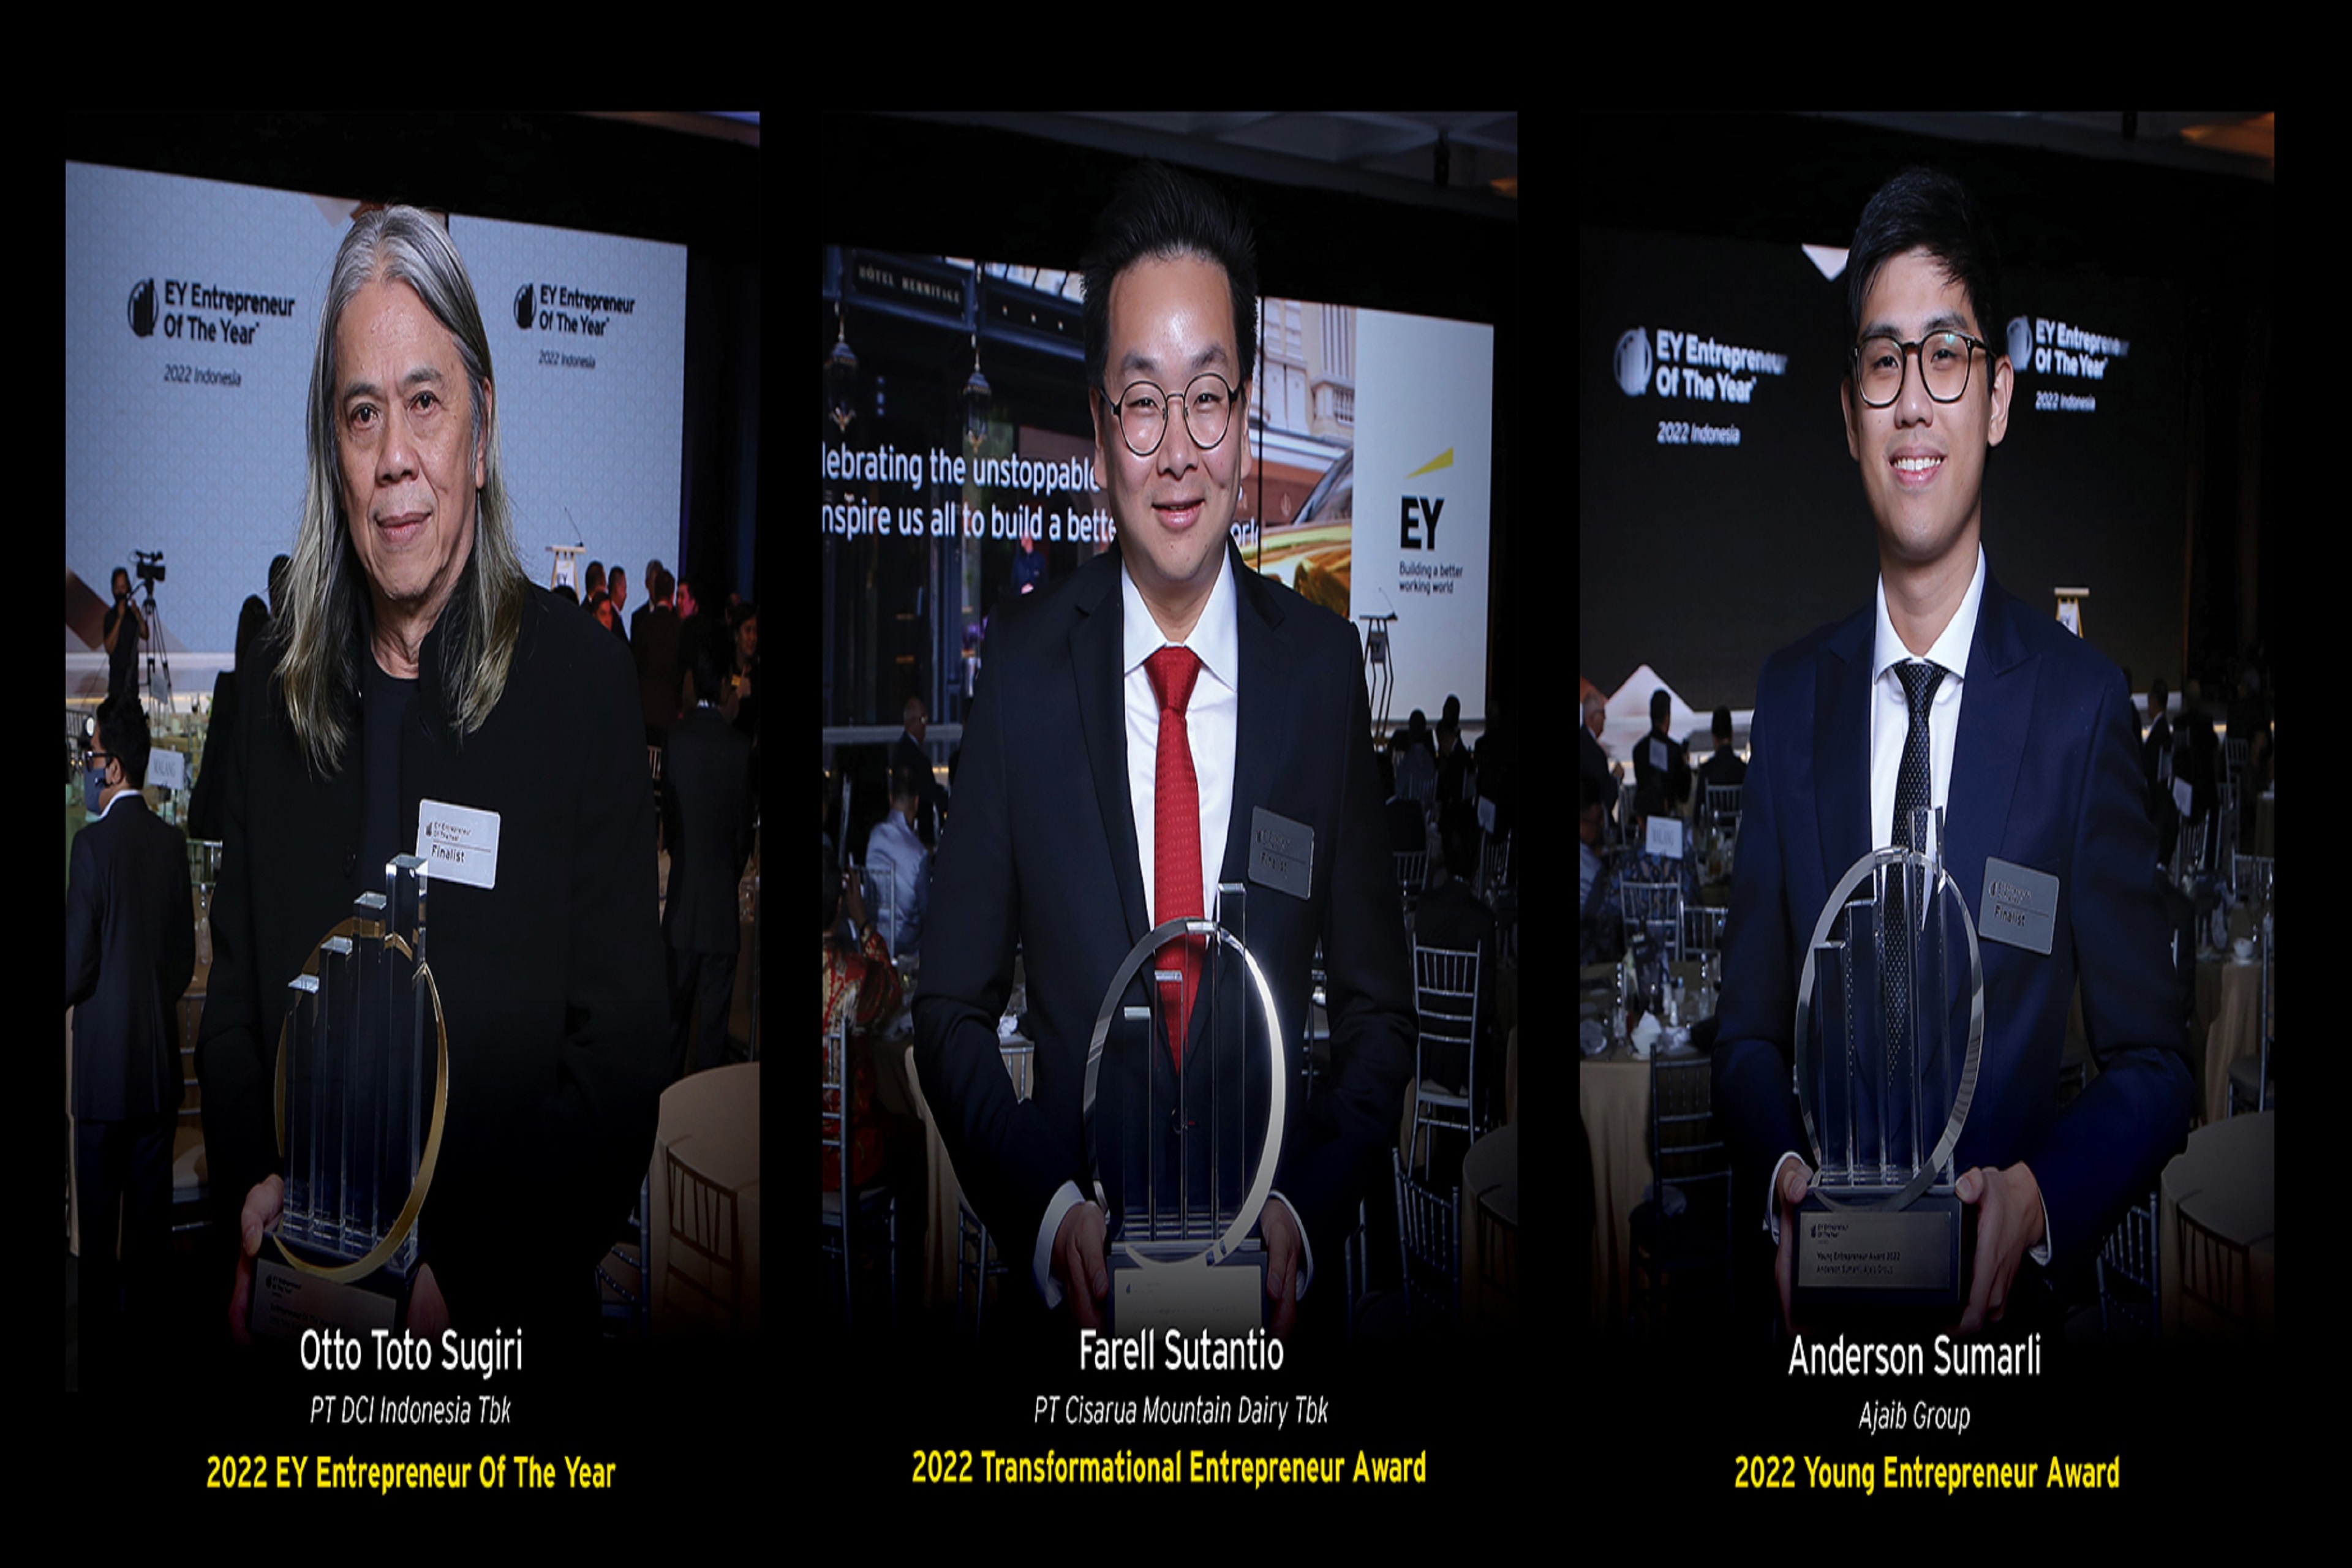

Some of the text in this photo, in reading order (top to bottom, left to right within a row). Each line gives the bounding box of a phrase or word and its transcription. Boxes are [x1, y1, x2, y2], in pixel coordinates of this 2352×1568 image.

[165, 279, 295, 317] EY Entrepreneur
[540, 284, 635, 314] EY Entrepreneur
[164, 312, 255, 345] Of The Year
[540, 309, 606, 336] Of The Year
[2035, 317, 2056, 344] EY
[1656, 329, 1787, 375] EY Entrepreneur
[2035, 347, 2052, 374] Of
[2054, 349, 2078, 378] The
[164, 364, 242, 386] 2022 Indonesia
[1656, 364, 1754, 404] Of The Year
[1657, 421, 1741, 447] 2022 Indonesia
[930, 447, 966, 486] the
[898, 507, 925, 537] us
[930, 500, 956, 538] all
[962, 501, 986, 538] to
[991, 502, 1043, 540] build
[1049, 513, 1062, 541] a
[1067, 507, 1117, 543] bette
[1400, 495, 1445, 551] EY
[1399, 560, 1463, 579] Building a better
[1399, 578, 1454, 596] working world
[431, 844, 465, 863] Finalist
[1994, 905, 2026, 927] Finalist
